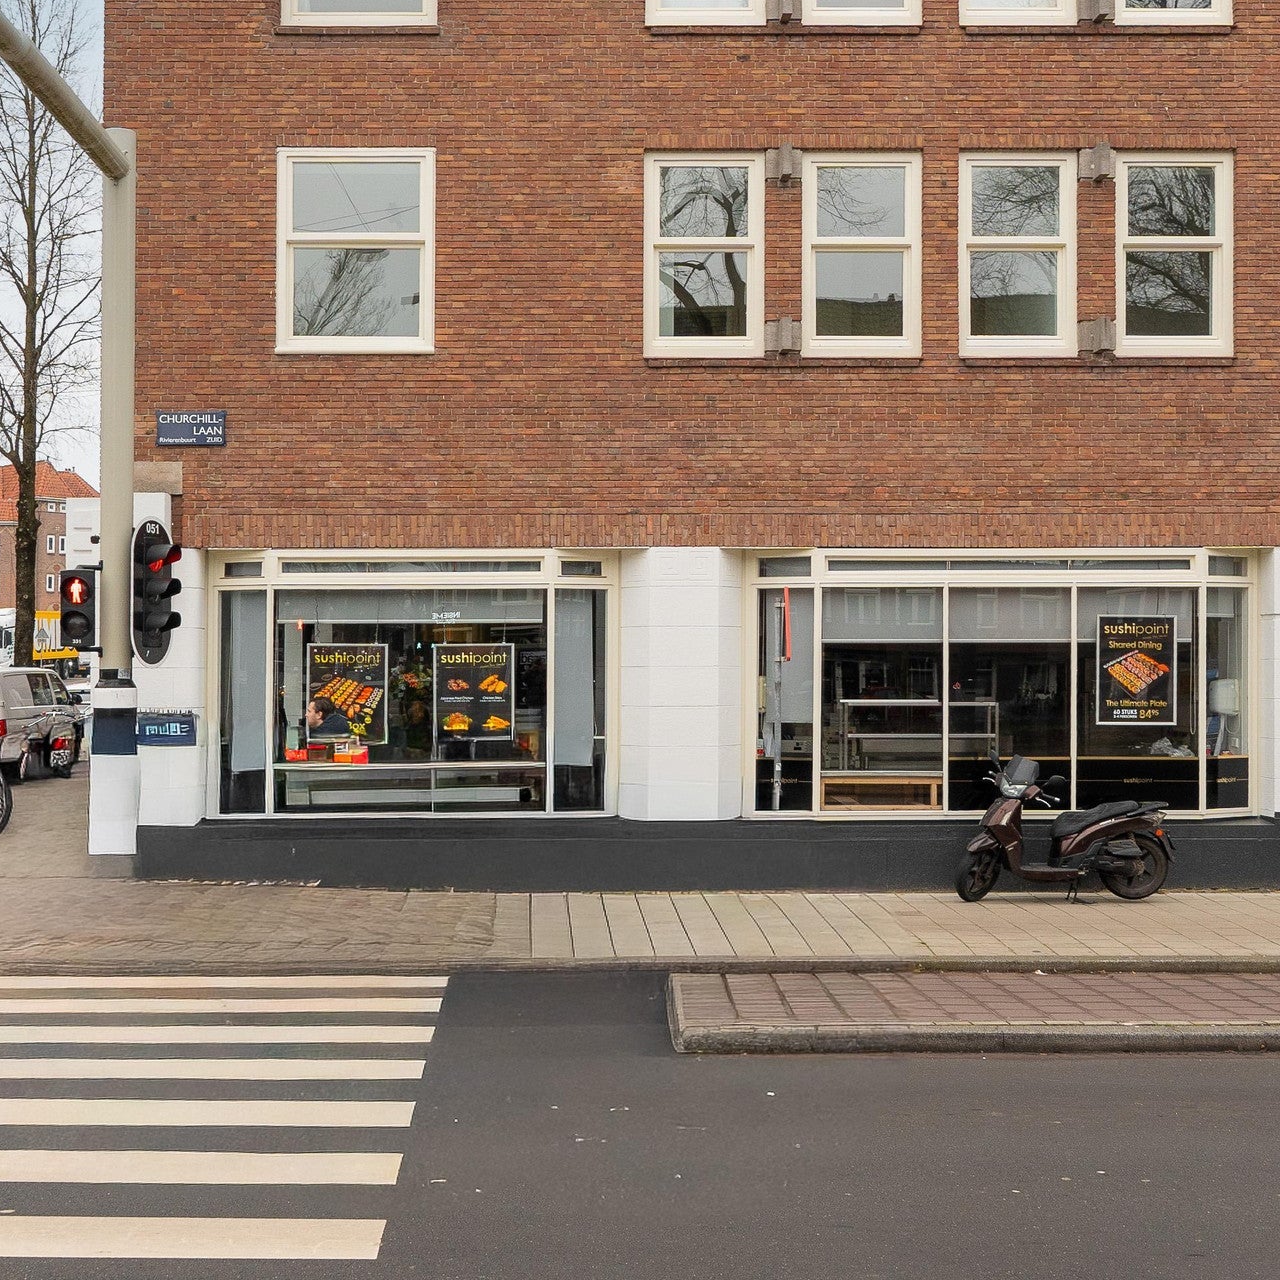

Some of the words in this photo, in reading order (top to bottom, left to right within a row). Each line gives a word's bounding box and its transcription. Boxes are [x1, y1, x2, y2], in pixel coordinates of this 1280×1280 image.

[159, 414, 222, 423] CHURCHILL-
[193, 426, 222, 435] LAAN
[146, 523, 160, 535] 051
[1104, 623, 1169, 637] sushipoint
[1109, 641, 1136, 649] Shared
[1138, 641, 1163, 650] Dining
[314, 652, 381, 666] sushipoint
[441, 652, 507, 666] sushipoint
